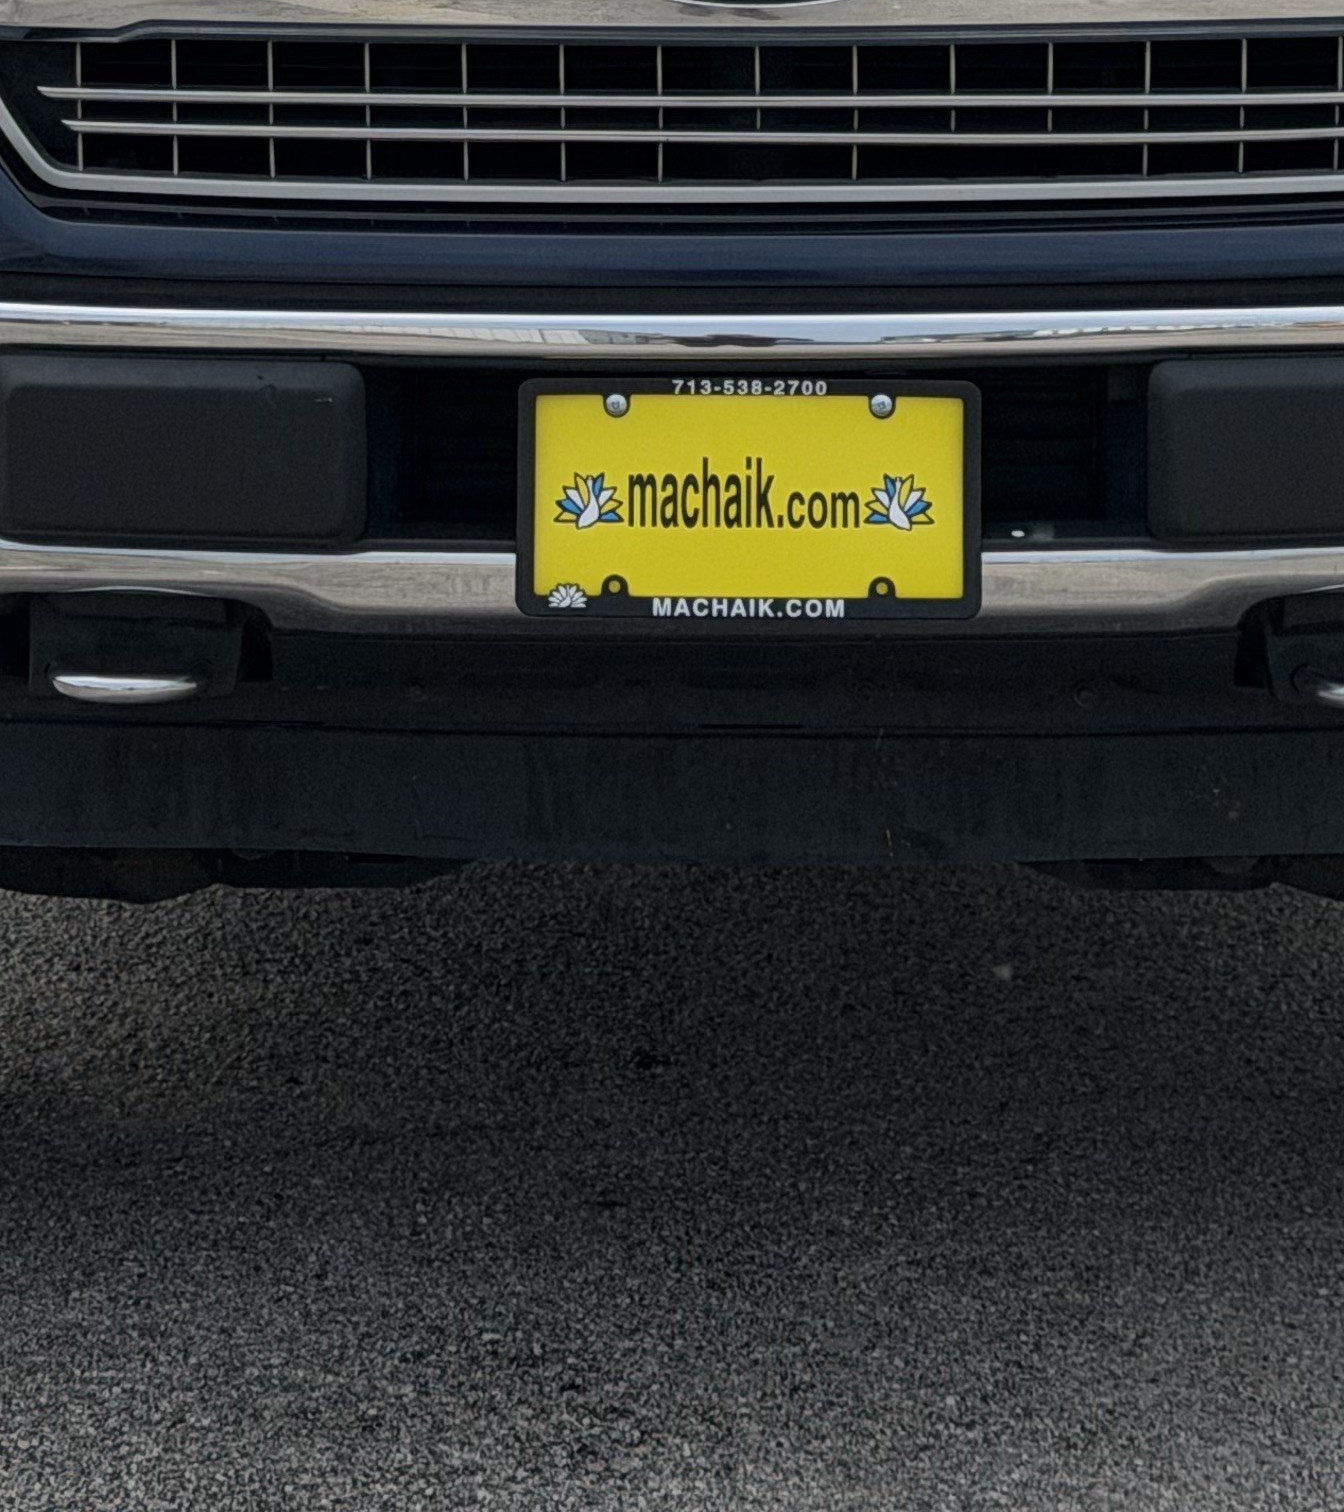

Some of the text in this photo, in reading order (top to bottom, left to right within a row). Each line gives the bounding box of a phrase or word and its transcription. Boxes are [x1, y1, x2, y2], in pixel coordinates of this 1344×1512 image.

[671, 379, 828, 396] 713-538-2700
[627, 456, 860, 529] machaik.com
[652, 598, 846, 619] MACHAIK.COM
